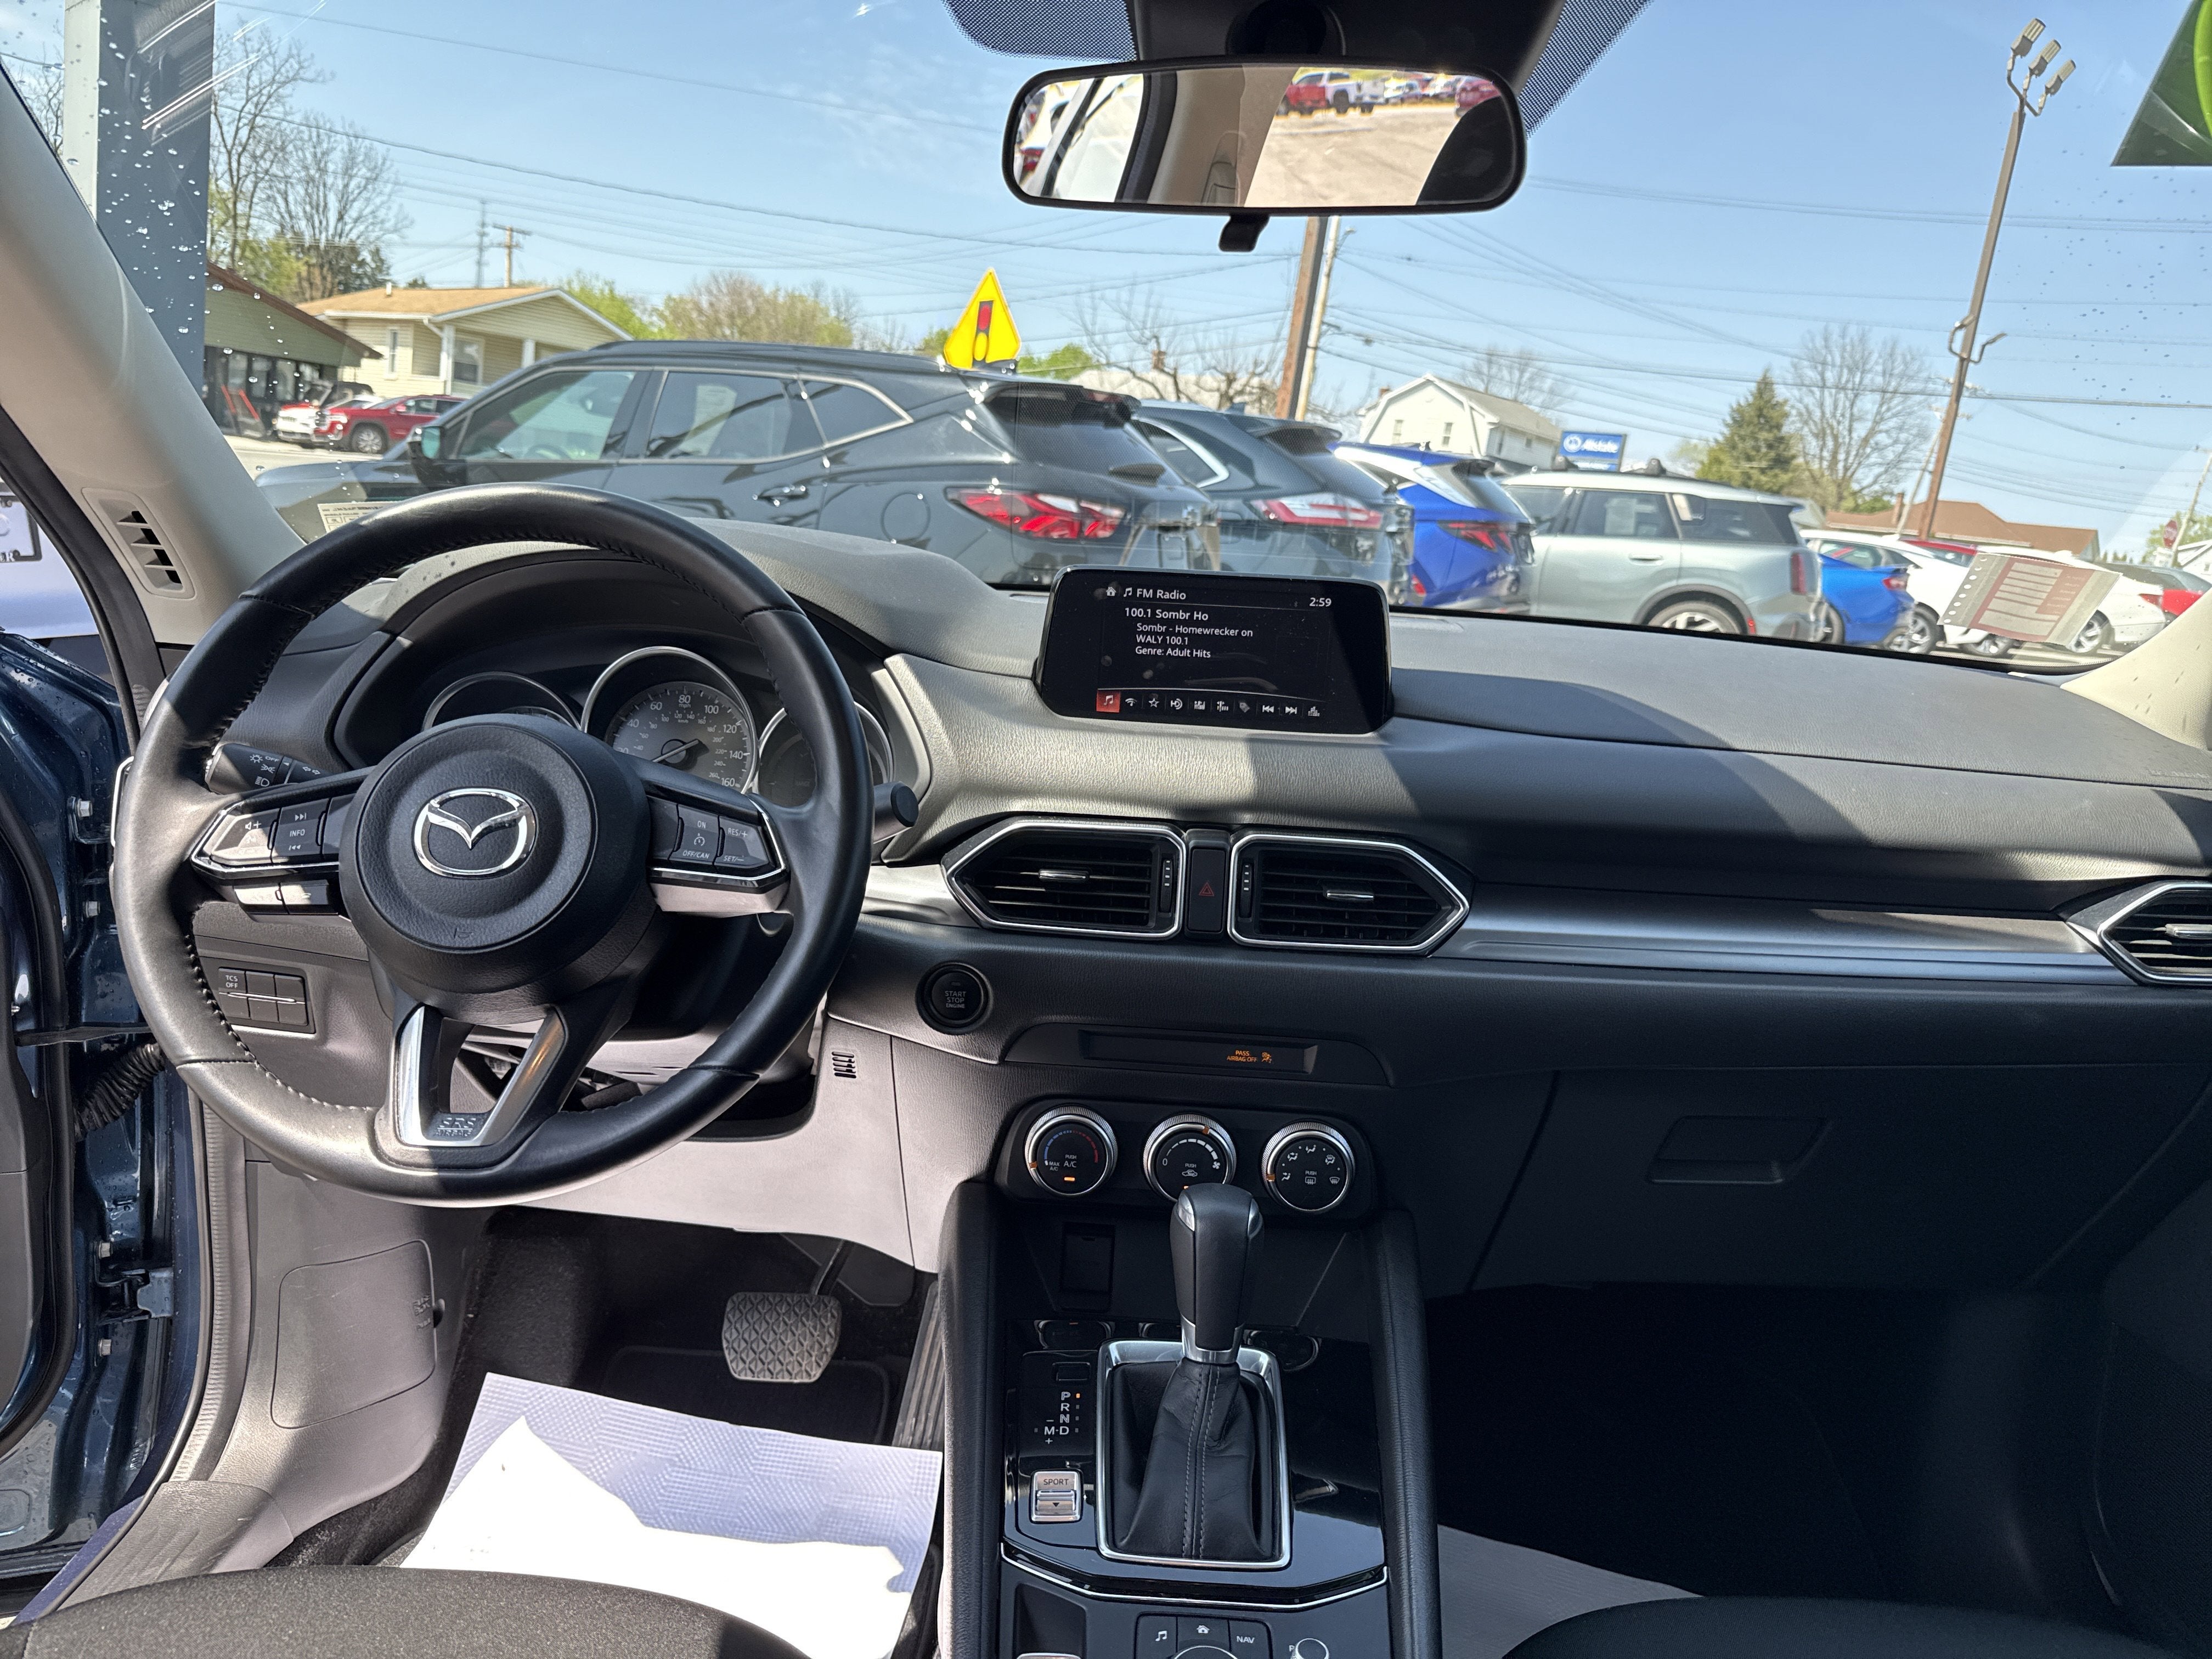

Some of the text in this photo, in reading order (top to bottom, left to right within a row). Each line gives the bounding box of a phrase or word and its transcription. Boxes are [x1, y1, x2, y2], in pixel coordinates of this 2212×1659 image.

[1137, 589, 1186, 600] FM Radio
[1309, 597, 1332, 607] 2:59
[1125, 607, 1209, 620] 100.1 Sombr Ho
[1137, 623, 1167, 632] Sombr
[1175, 625, 1239, 636] Homewrecker
[1136, 634, 1188, 645] WALY 100.1
[1135, 646, 1211, 658] Genre: Adult Hits
[679, 695, 691, 703] 80
[650, 702, 662, 710] 60
[704, 706, 719, 714] 100
[627, 719, 639, 727] 40
[723, 724, 737, 733] 120
[729, 751, 743, 759] 140
[721, 778, 735, 787] 160
[290, 829, 306, 837] INFO
[682, 851, 709, 859] OFF/CAN
[1061, 1391, 1071, 1401] P
[1060, 1403, 1070, 1412] R
[1059, 1414, 1070, 1423] N
[1236, 1635, 1255, 1644] NAV
